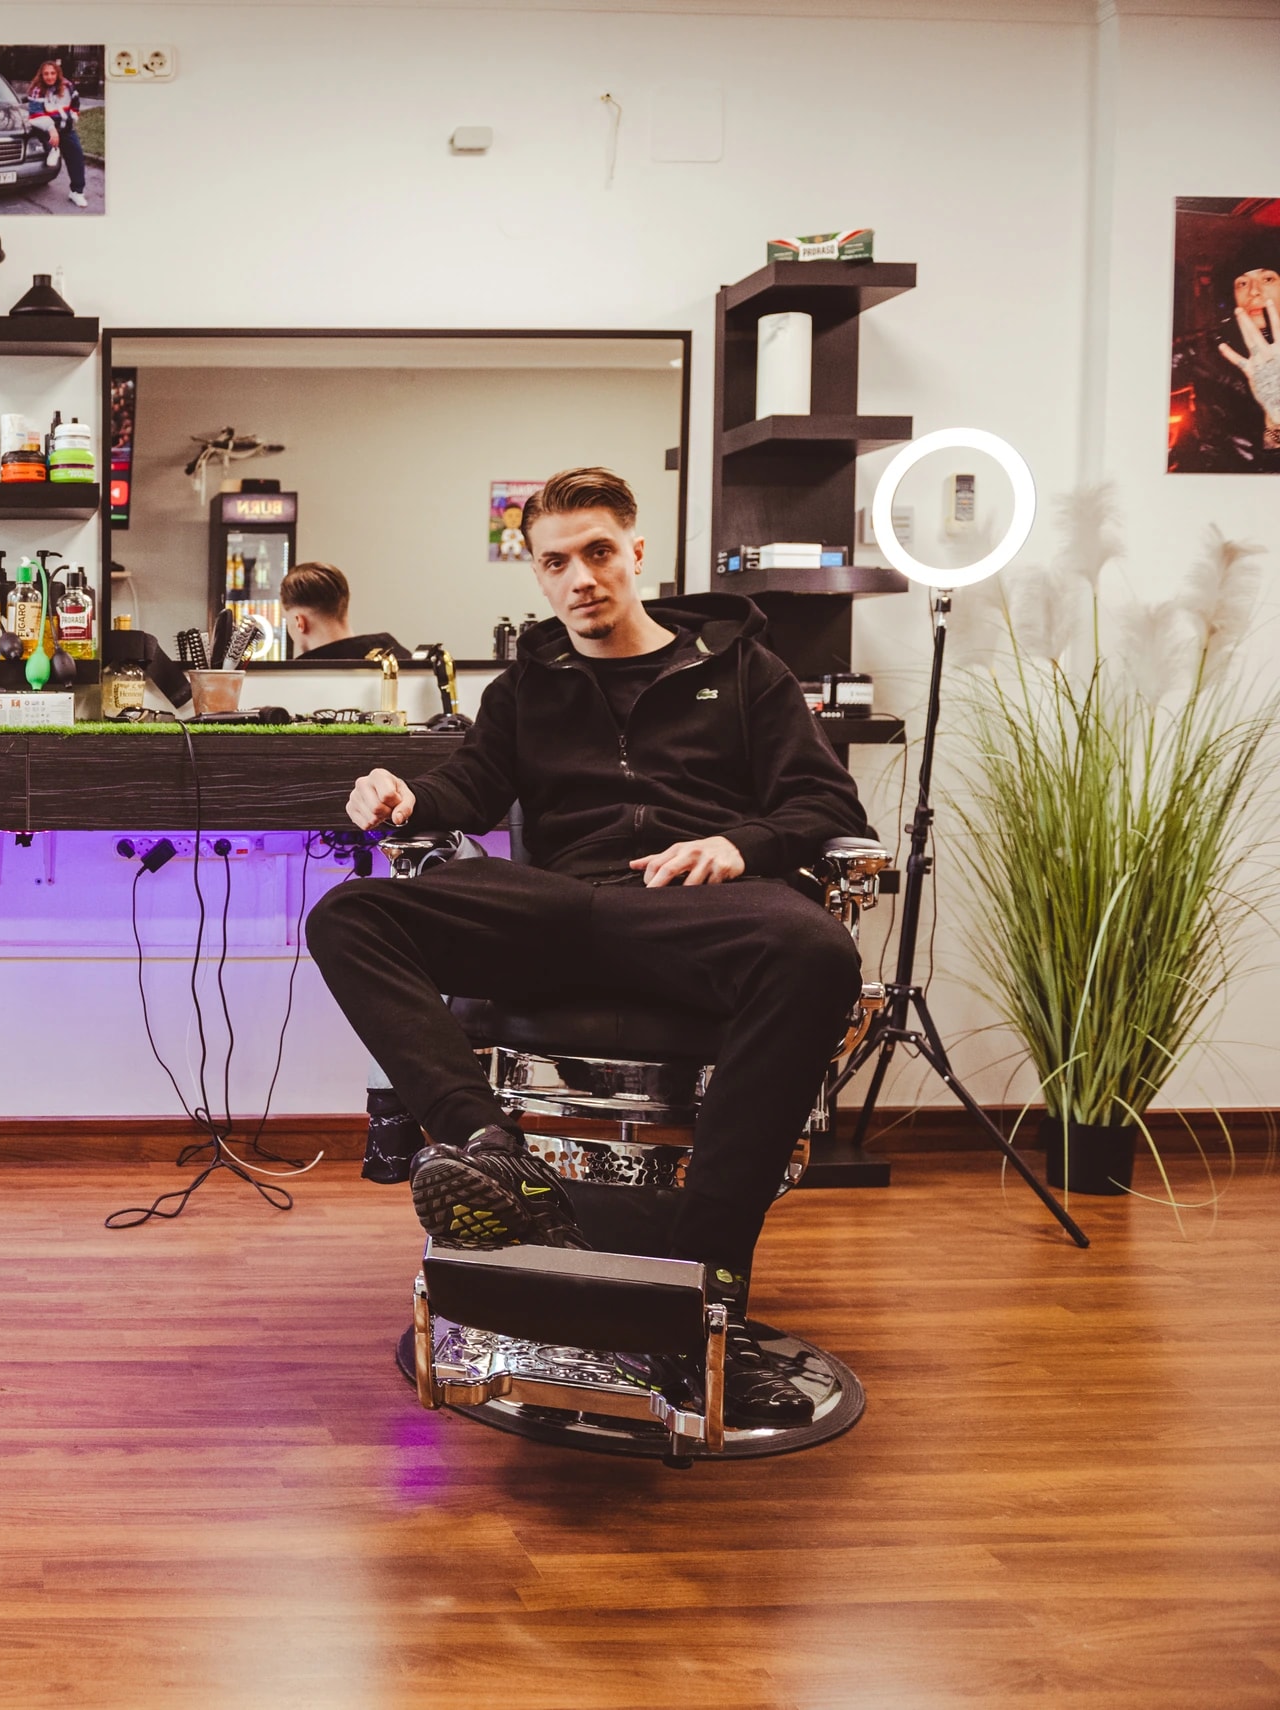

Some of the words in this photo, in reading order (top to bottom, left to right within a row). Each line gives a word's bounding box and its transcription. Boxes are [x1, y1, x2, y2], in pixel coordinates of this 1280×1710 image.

[802, 244, 836, 257] PRORASO
[18, 603, 26, 638] FIGARO
[61, 614, 86, 624] PRORASO
